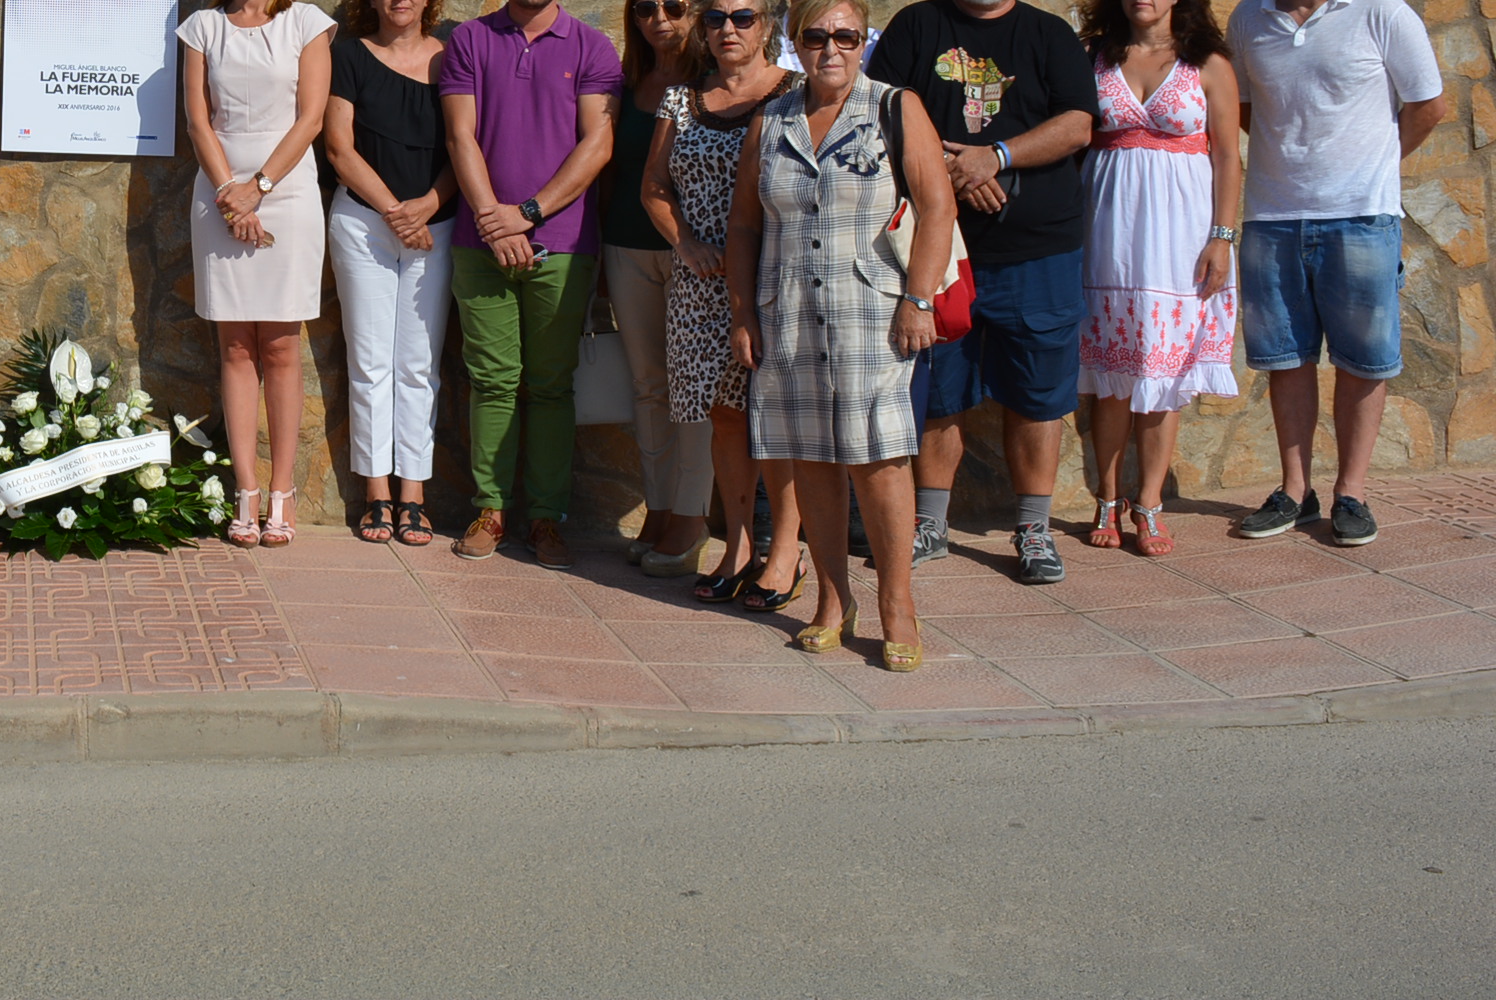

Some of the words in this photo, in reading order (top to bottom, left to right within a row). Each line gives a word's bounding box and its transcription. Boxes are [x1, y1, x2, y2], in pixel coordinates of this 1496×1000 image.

[40, 71, 58, 82] LA
[62, 71, 117, 84] FUERZA
[121, 73, 140, 85] DE
[45, 83, 64, 94] LA
[67, 84, 134, 96] MEMORIA
[6, 469, 57, 490] ALCALDESA
[16, 487, 22, 496] Y
[24, 485, 37, 494] LA
[98, 454, 141, 469] MUNICIPAL
